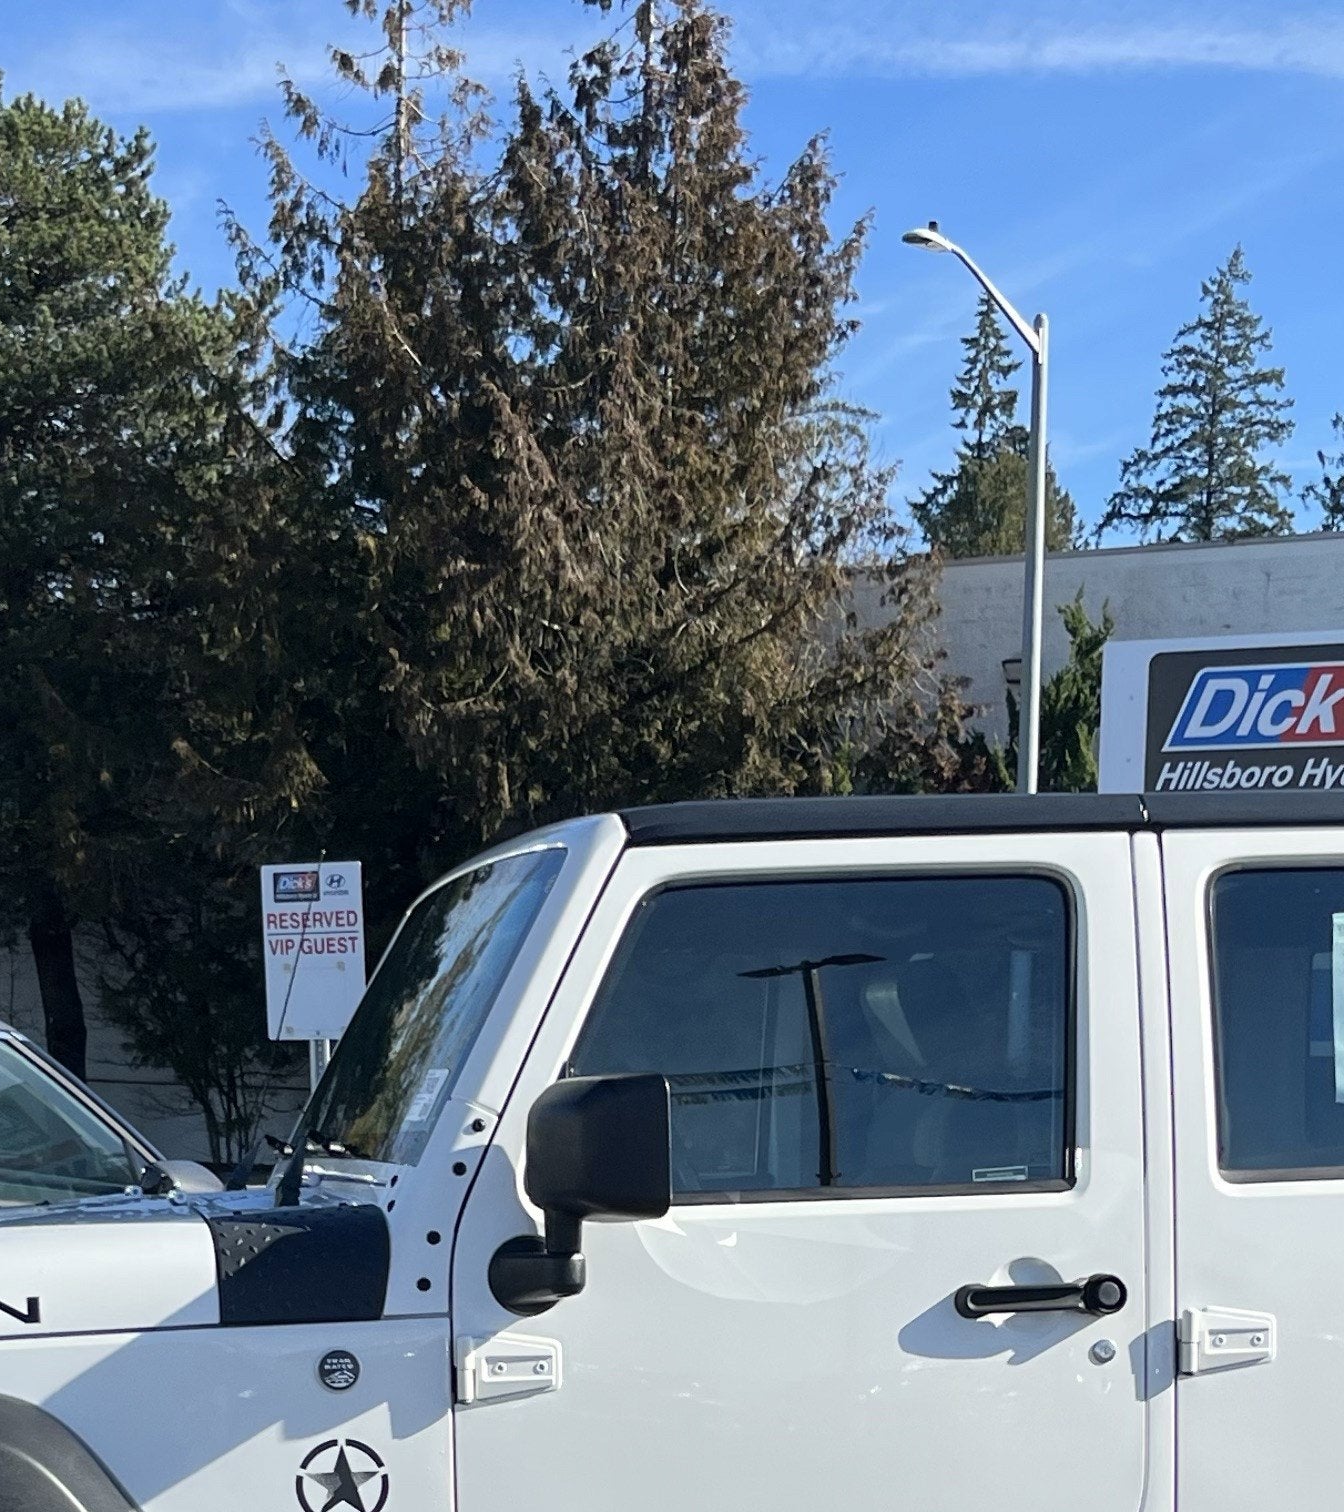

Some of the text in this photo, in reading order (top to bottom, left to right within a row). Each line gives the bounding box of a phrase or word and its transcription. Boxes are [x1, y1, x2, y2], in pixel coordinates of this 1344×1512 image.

[1156, 760, 1294, 791] Hillsboro
[267, 910, 358, 930] RESERVED
[269, 936, 358, 956] VIP GUEST
